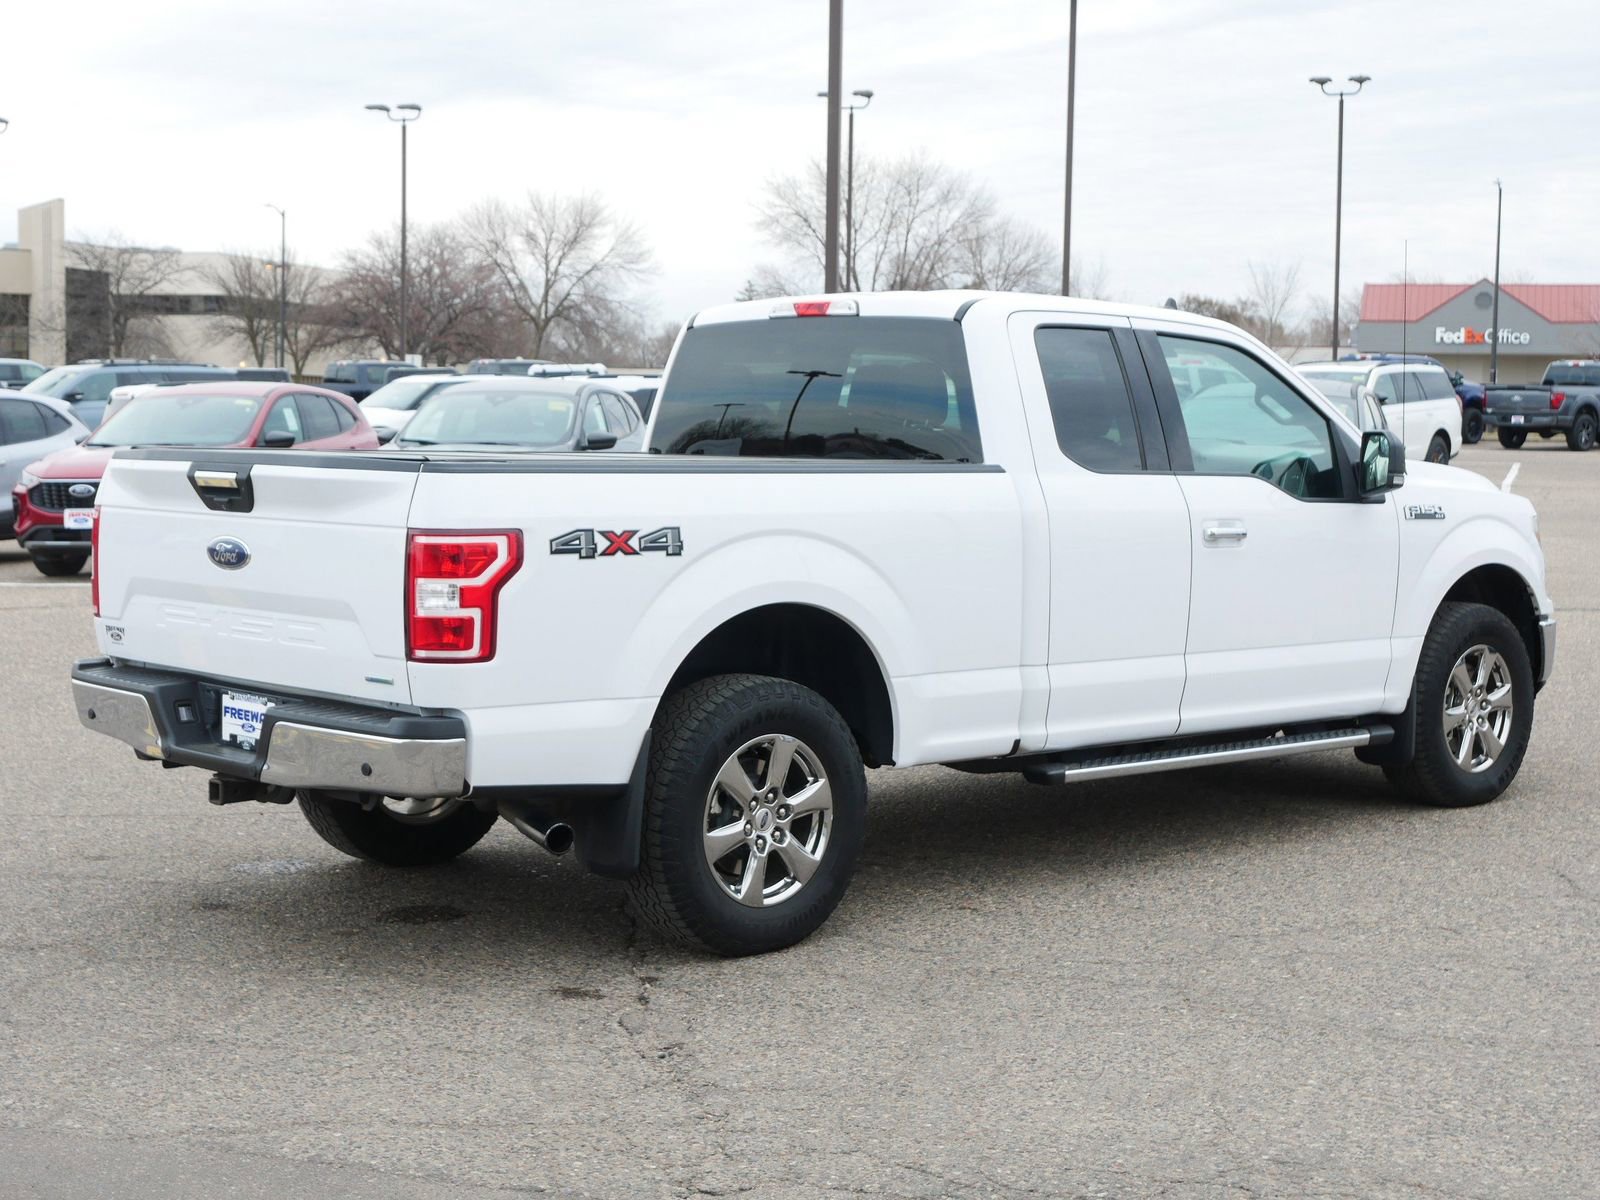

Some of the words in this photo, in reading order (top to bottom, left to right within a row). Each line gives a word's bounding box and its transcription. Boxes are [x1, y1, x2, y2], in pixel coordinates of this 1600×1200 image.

[1435, 326, 1485, 345] FedEx
[1484, 328, 1530, 345] Office
[213, 541, 240, 563] Ford
[223, 706, 265, 724] FREEWA
